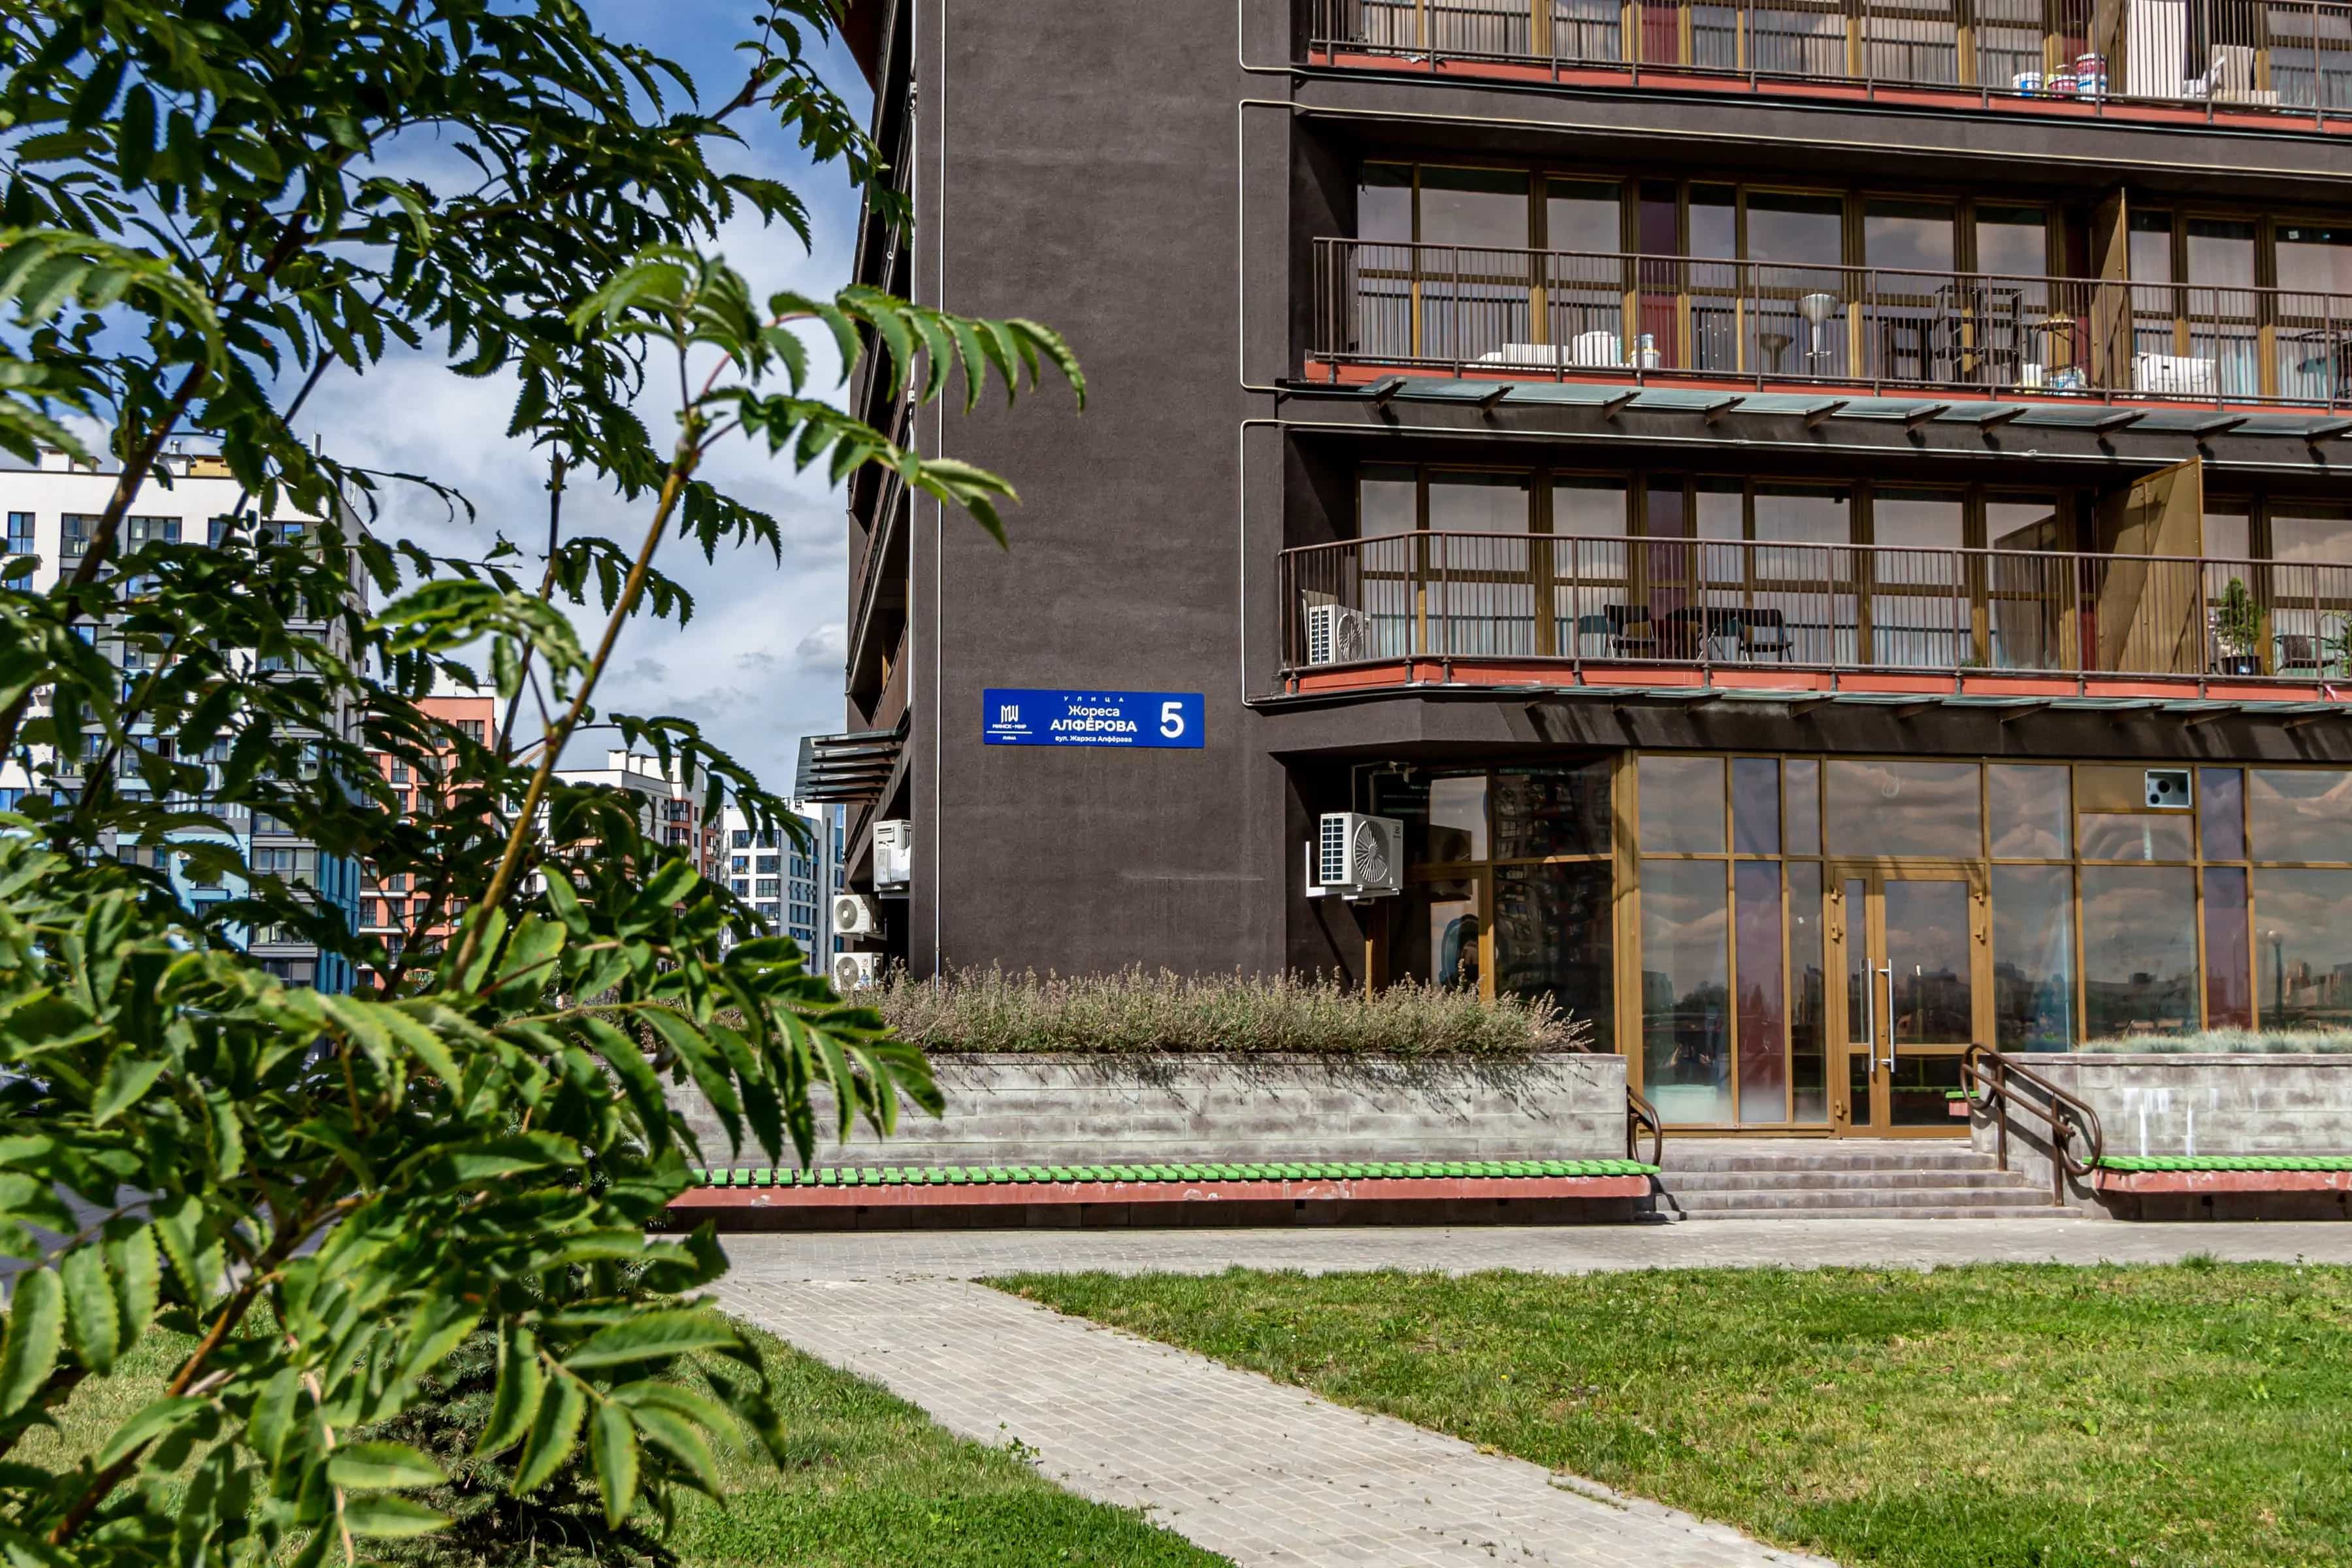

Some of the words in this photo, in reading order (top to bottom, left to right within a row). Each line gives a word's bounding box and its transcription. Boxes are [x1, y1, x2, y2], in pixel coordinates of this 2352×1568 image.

[1068, 706, 1120, 718] Жореса
[1050, 717, 1137, 732] АЛФЁРОВА
[1160, 702, 1184, 738] 5
